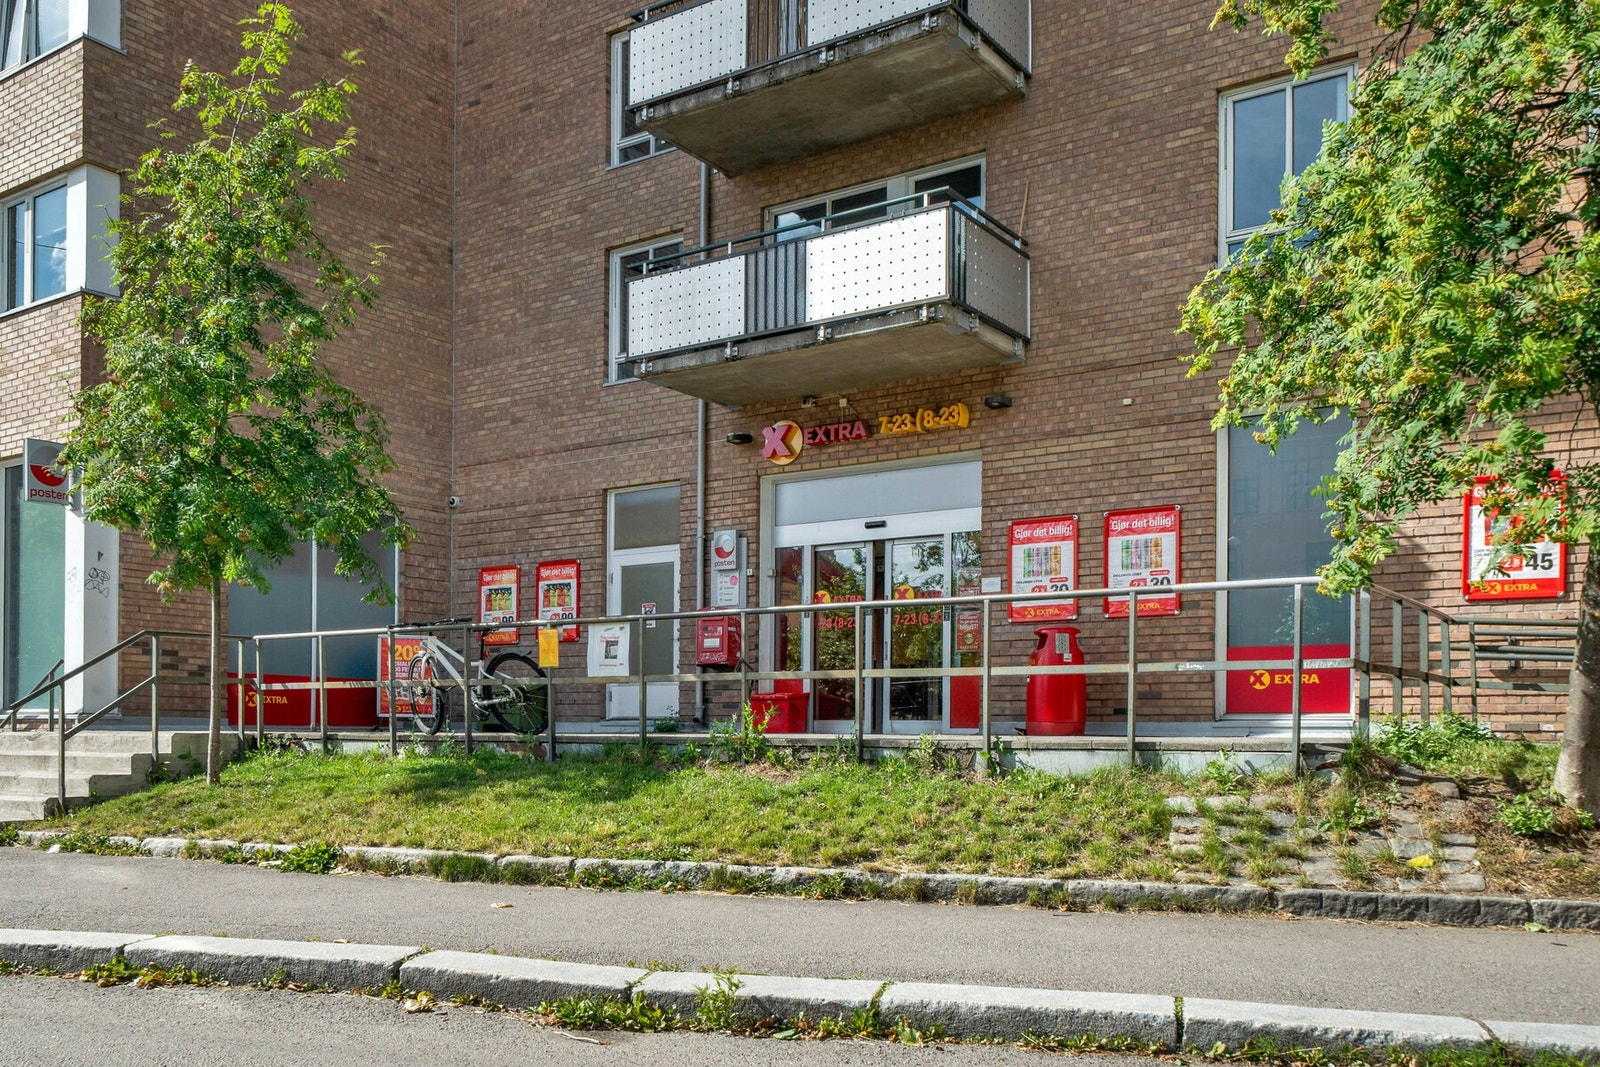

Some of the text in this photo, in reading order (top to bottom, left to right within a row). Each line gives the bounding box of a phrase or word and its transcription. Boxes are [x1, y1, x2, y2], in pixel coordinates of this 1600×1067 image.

[804, 421, 870, 446] EXTRA
[879, 413, 914, 435] 7-23
[916, 403, 969, 432] (8-23)
[1112, 515, 1174, 532] Gjør det billig!
[1014, 525, 1073, 540] Gjør det billig!
[714, 560, 736, 568] posten
[1525, 552, 1554, 571] 45
[1504, 583, 1538, 592] EXTRA
[917, 589, 943, 599] EXTR
[1036, 608, 1060, 616] EXTRA
[894, 613, 917, 626] 7-23
[1274, 673, 1320, 684] EXRA
